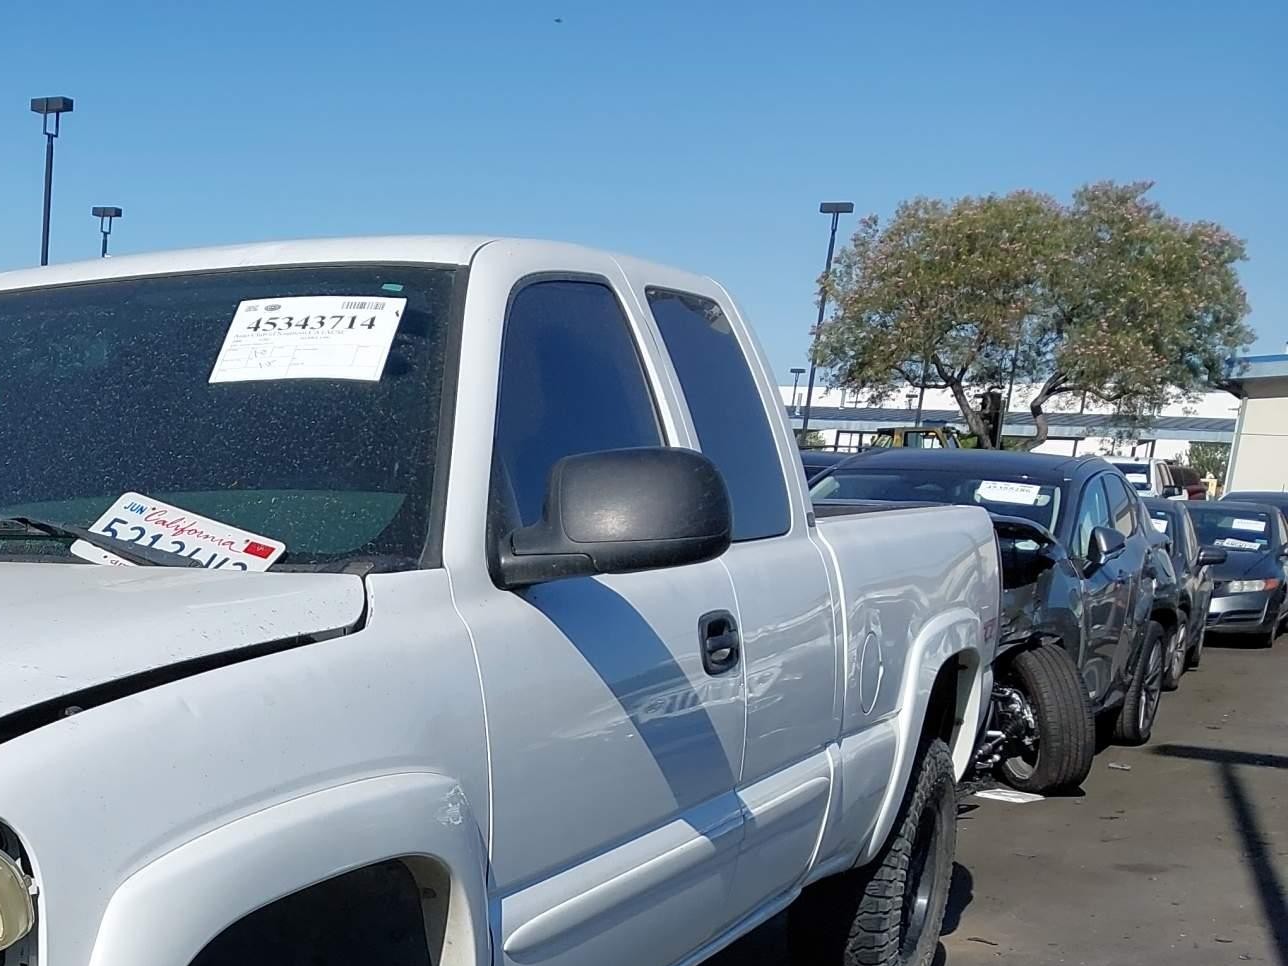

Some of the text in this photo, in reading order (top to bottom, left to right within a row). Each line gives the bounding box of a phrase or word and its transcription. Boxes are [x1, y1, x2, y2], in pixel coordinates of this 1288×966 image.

[246, 314, 377, 332] 45343714
[123, 501, 148, 516] JUN
[144, 509, 243, 554] California
